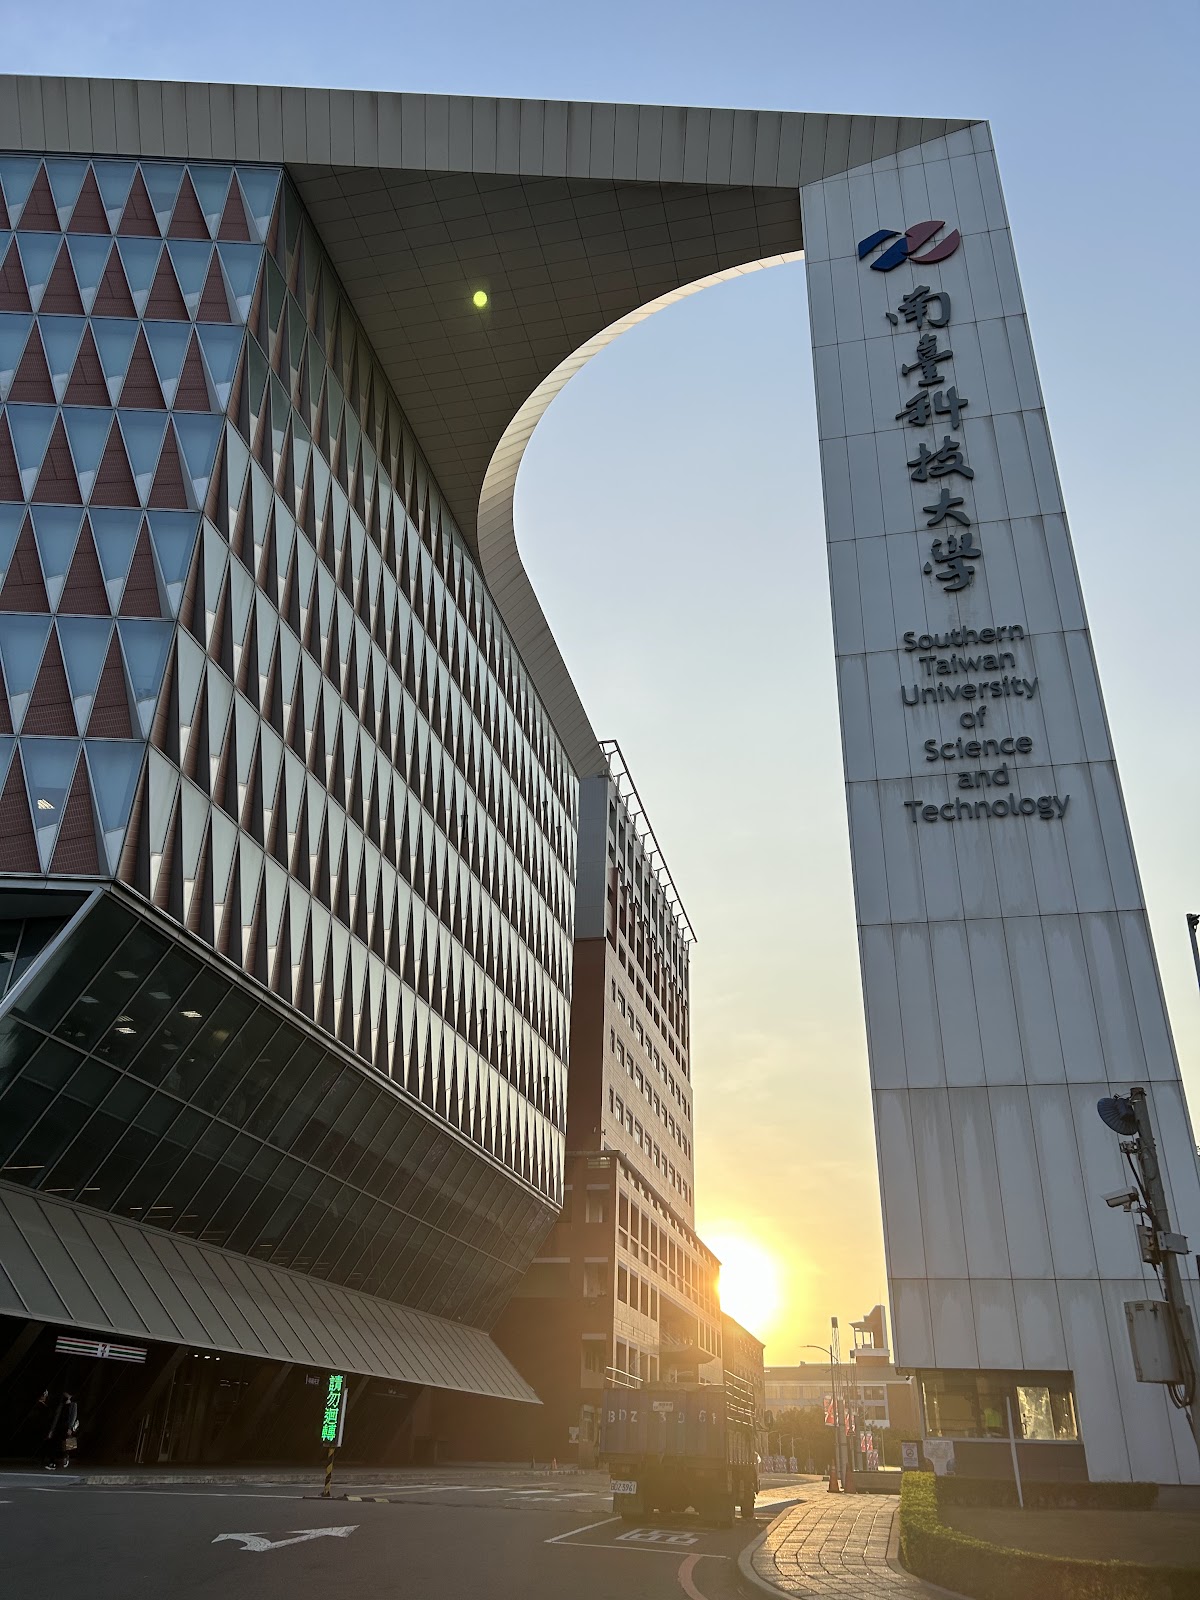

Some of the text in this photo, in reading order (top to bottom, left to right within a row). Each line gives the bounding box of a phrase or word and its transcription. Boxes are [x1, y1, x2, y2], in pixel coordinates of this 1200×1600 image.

[885, 284, 981, 591] 南臺科技大學
[903, 624, 1024, 652] Southern
[918, 651, 1015, 676] Taiwan
[901, 675, 1039, 706] University
[959, 705, 987, 729] of
[924, 735, 1033, 762] Science
[957, 762, 1010, 789] and
[903, 792, 1070, 823] Technology
[321, 1375, 343, 1442] 請勿迴轉
